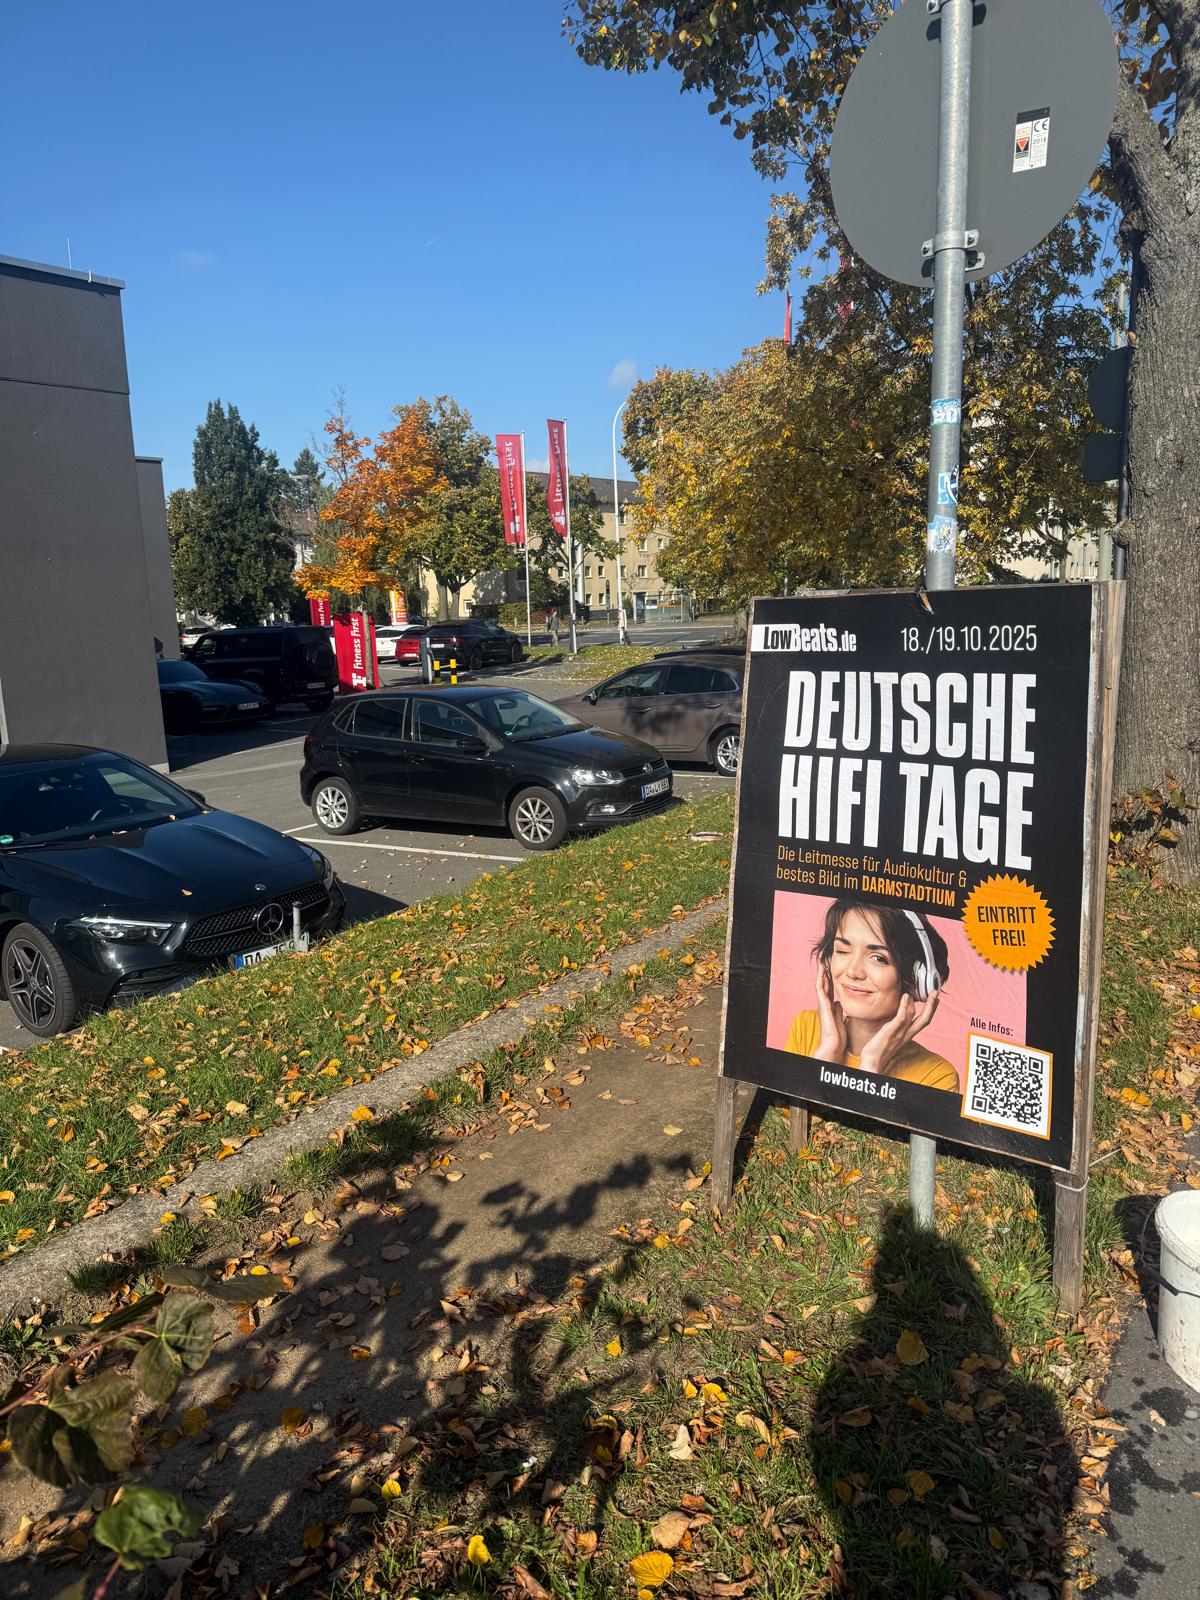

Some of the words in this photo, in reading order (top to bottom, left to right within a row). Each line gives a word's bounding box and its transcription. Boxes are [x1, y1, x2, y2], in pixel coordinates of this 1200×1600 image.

[1034, 119, 1048, 132] CE
[763, 623, 857, 652] LowBeats.de
[900, 625, 1037, 654] 18./19.10.2025
[783, 671, 1037, 764] DEUTSCHE
[778, 754, 882, 848] HIFI
[899, 761, 1034, 871] TAGE
[777, 845, 795, 861] Die
[798, 848, 859, 869] Leitmesse
[863, 856, 880, 872] für
[883, 858, 955, 885] Audiokultur
[958, 870, 967, 888] &
[776, 864, 815, 884] bestes
[818, 869, 840, 887] Bild
[844, 873, 858, 890] im
[862, 875, 956, 907] DARMSTADTIUM
[977, 906, 1036, 924] EINTRITT
[992, 929, 1026, 947] FREI!
[970, 1017, 986, 1030] Alle
[988, 1021, 1014, 1036] Infos:
[820, 1066, 897, 1100] lowbeats.de
